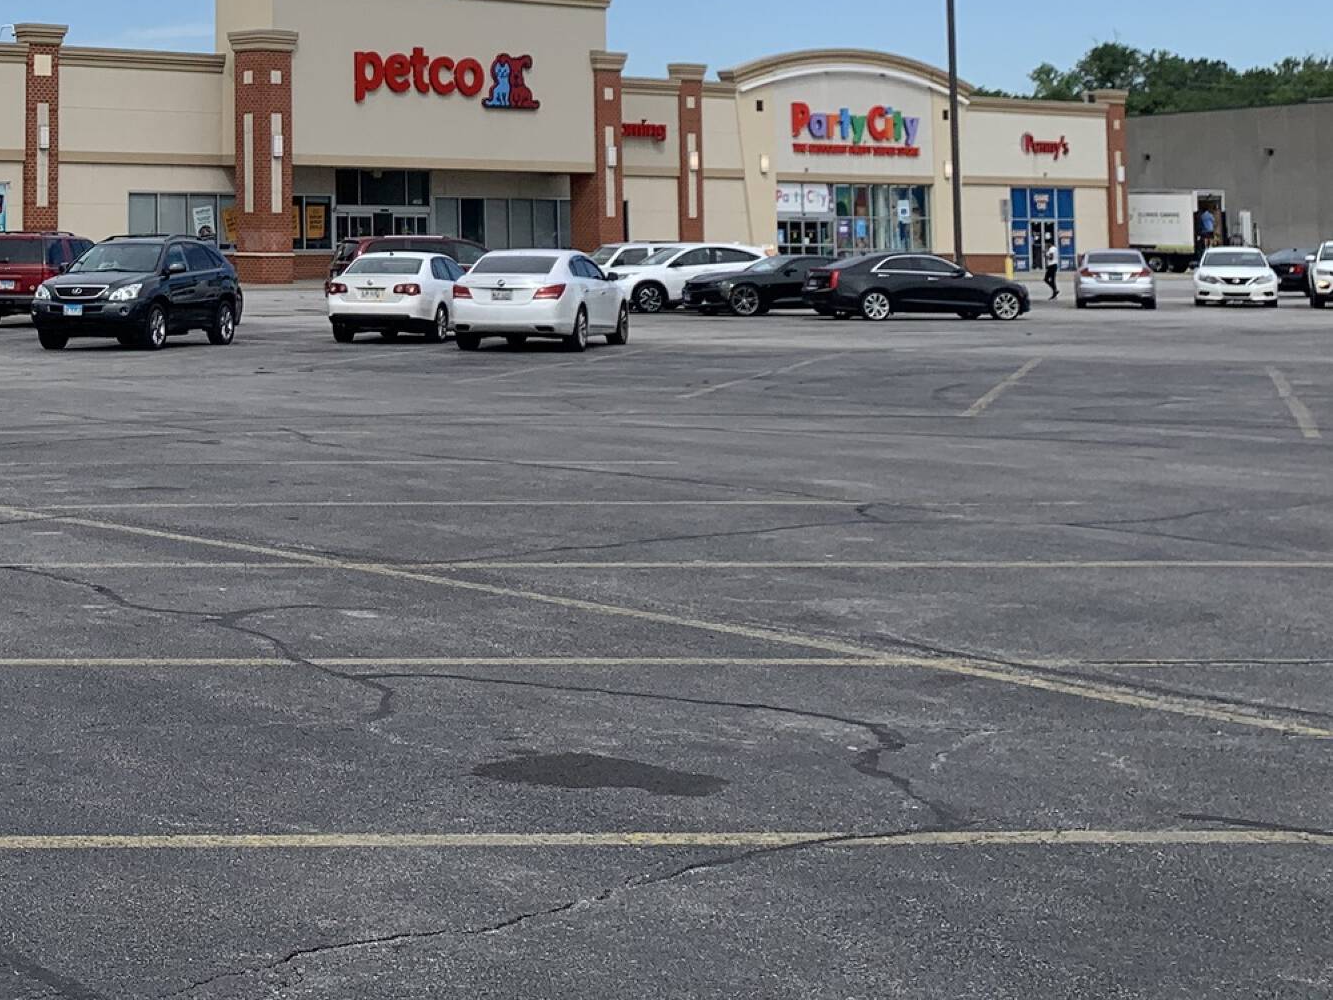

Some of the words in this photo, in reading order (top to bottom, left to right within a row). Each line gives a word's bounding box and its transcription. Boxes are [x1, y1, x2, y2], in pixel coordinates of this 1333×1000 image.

[353, 47, 485, 103] petco
[790, 101, 867, 146] Party
[867, 104, 919, 147] City
